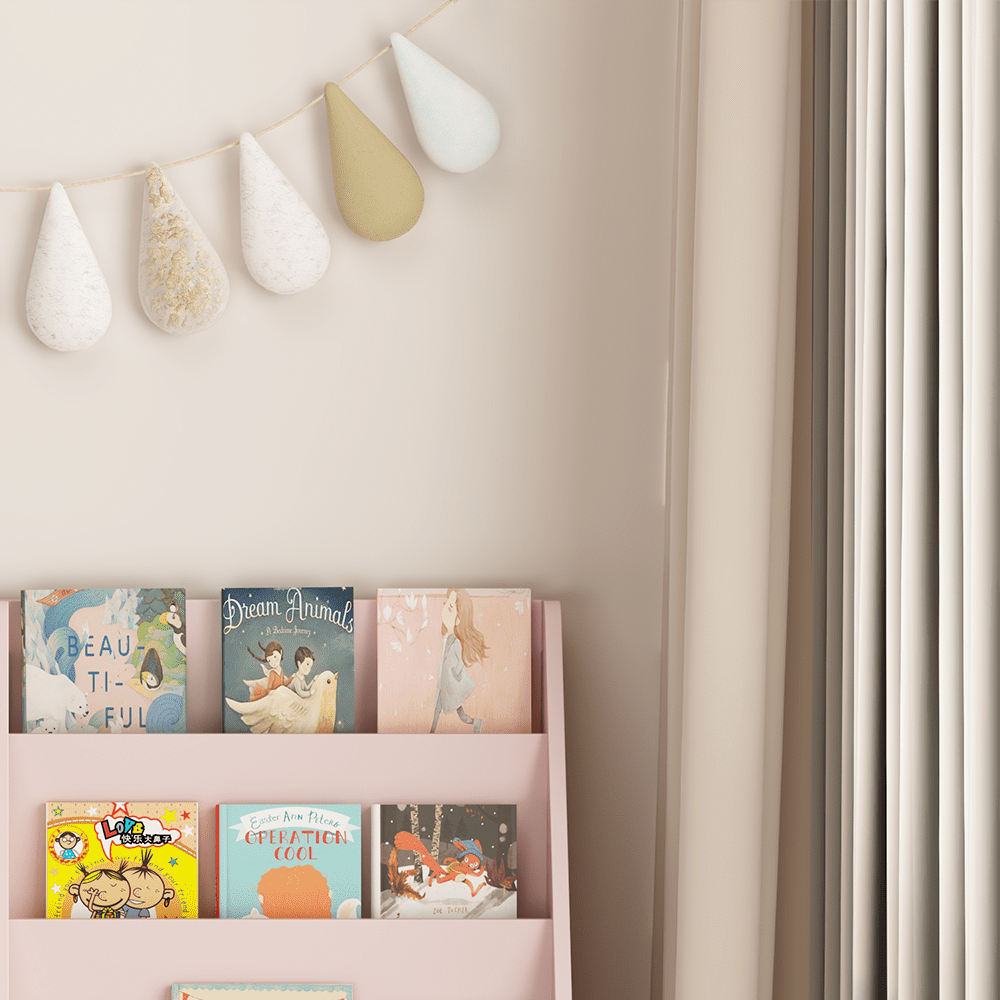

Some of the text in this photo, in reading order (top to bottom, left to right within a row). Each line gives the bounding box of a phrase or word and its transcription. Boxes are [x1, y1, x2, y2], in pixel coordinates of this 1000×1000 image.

[222, 587, 354, 635] Dream Animals
[67, 635, 145, 657] BEAU-
[87, 671, 124, 693] TI-
[105, 706, 147, 729] FUL
[120, 833, 172, 845] 快乐大鼻子
[244, 829, 348, 845] OPERATION
[273, 846, 318, 861] COOL
